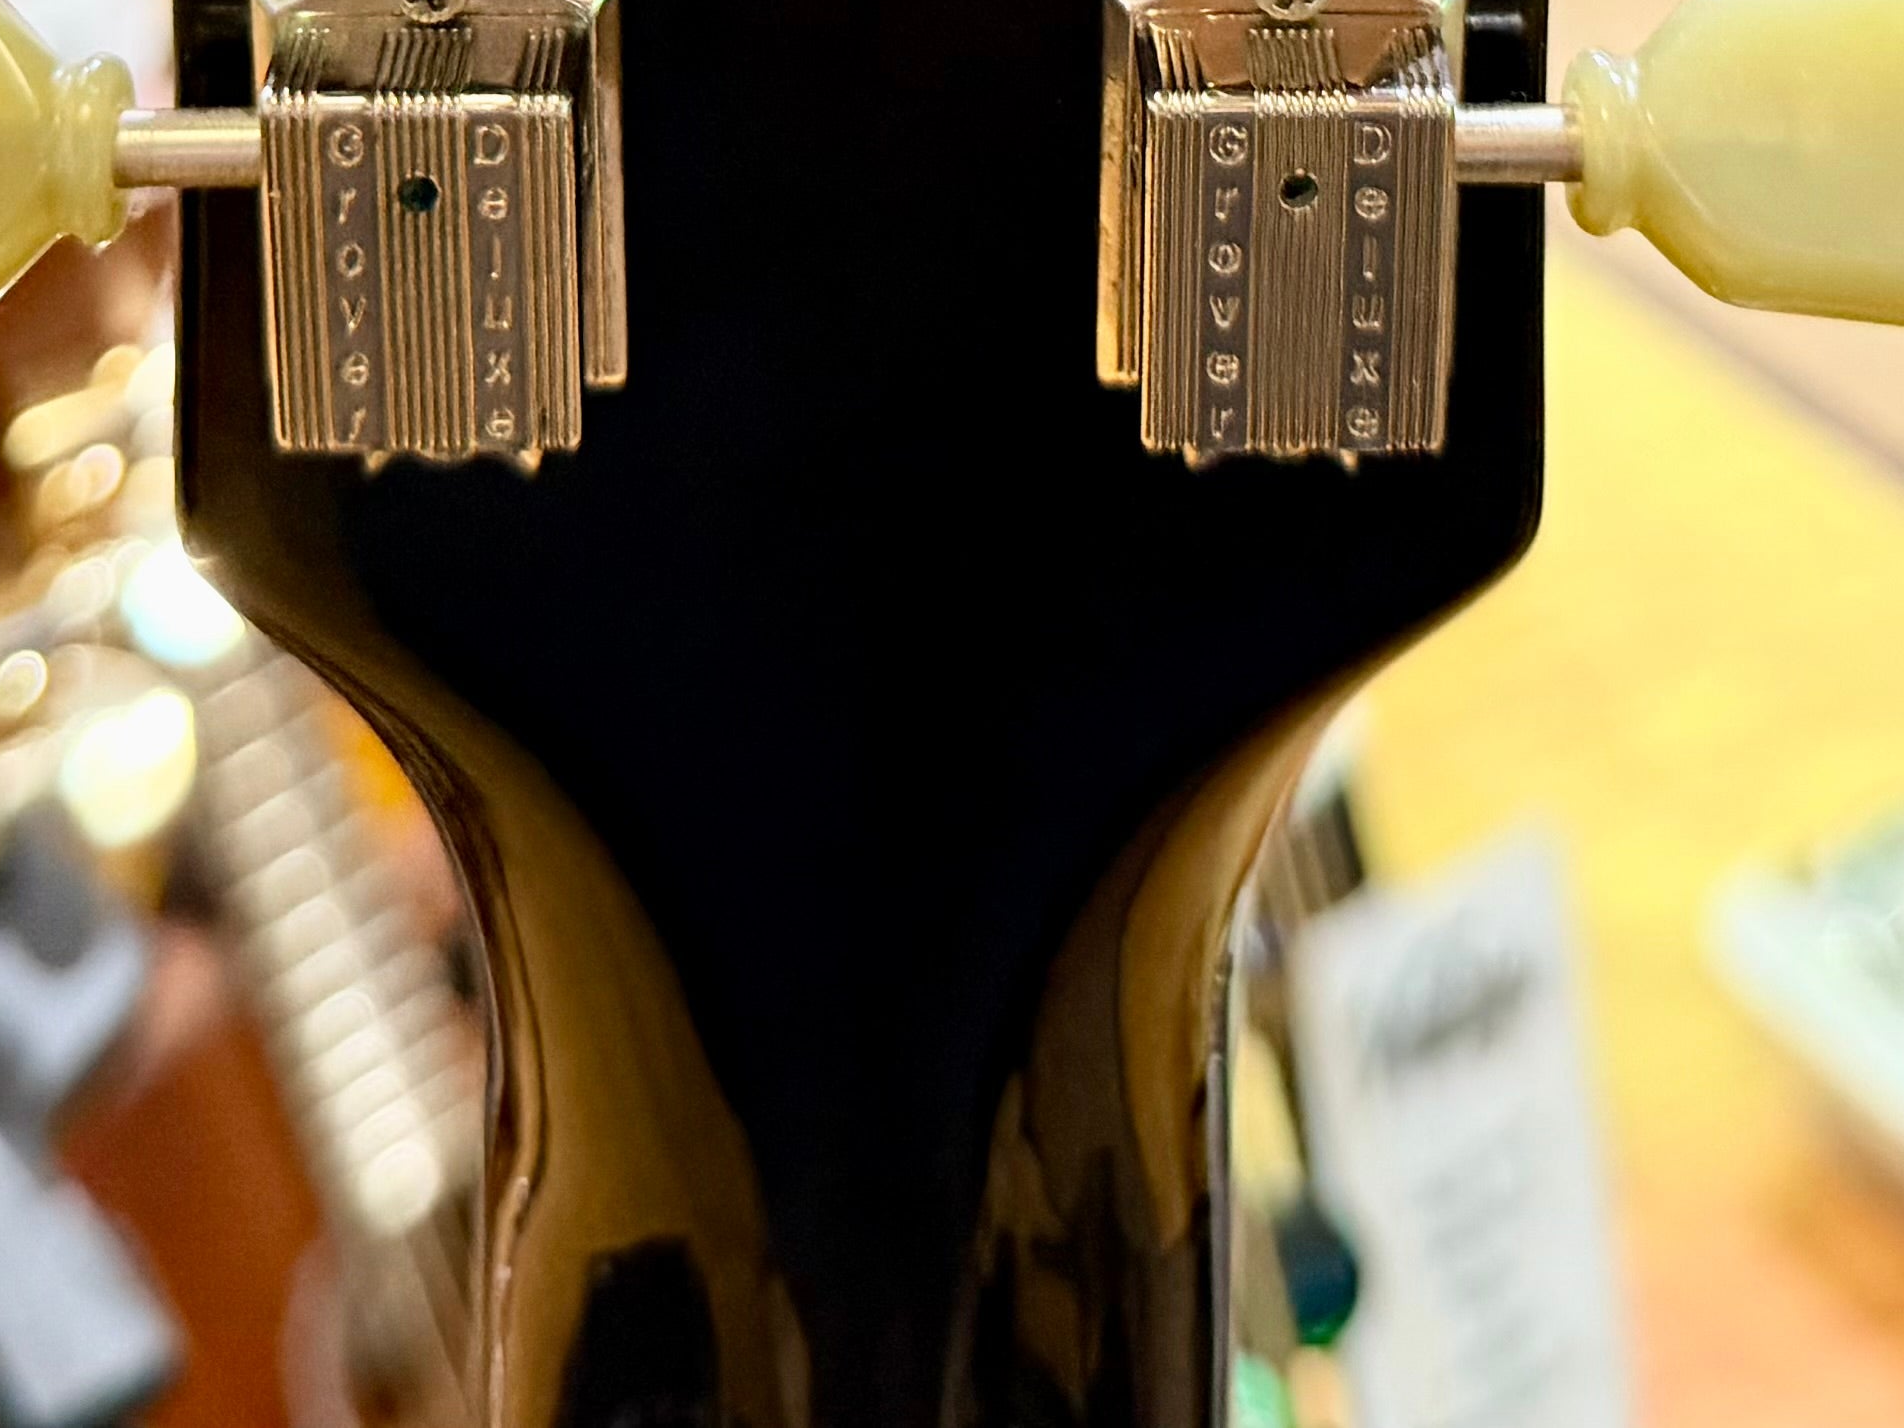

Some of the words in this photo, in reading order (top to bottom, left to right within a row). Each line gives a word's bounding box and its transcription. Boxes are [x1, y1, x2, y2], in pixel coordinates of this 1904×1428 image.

[326, 123, 371, 443] Grover
[473, 123, 516, 439] Deluxe
[1205, 121, 1249, 441] Grover
[1344, 121, 1392, 438] Deluxe
